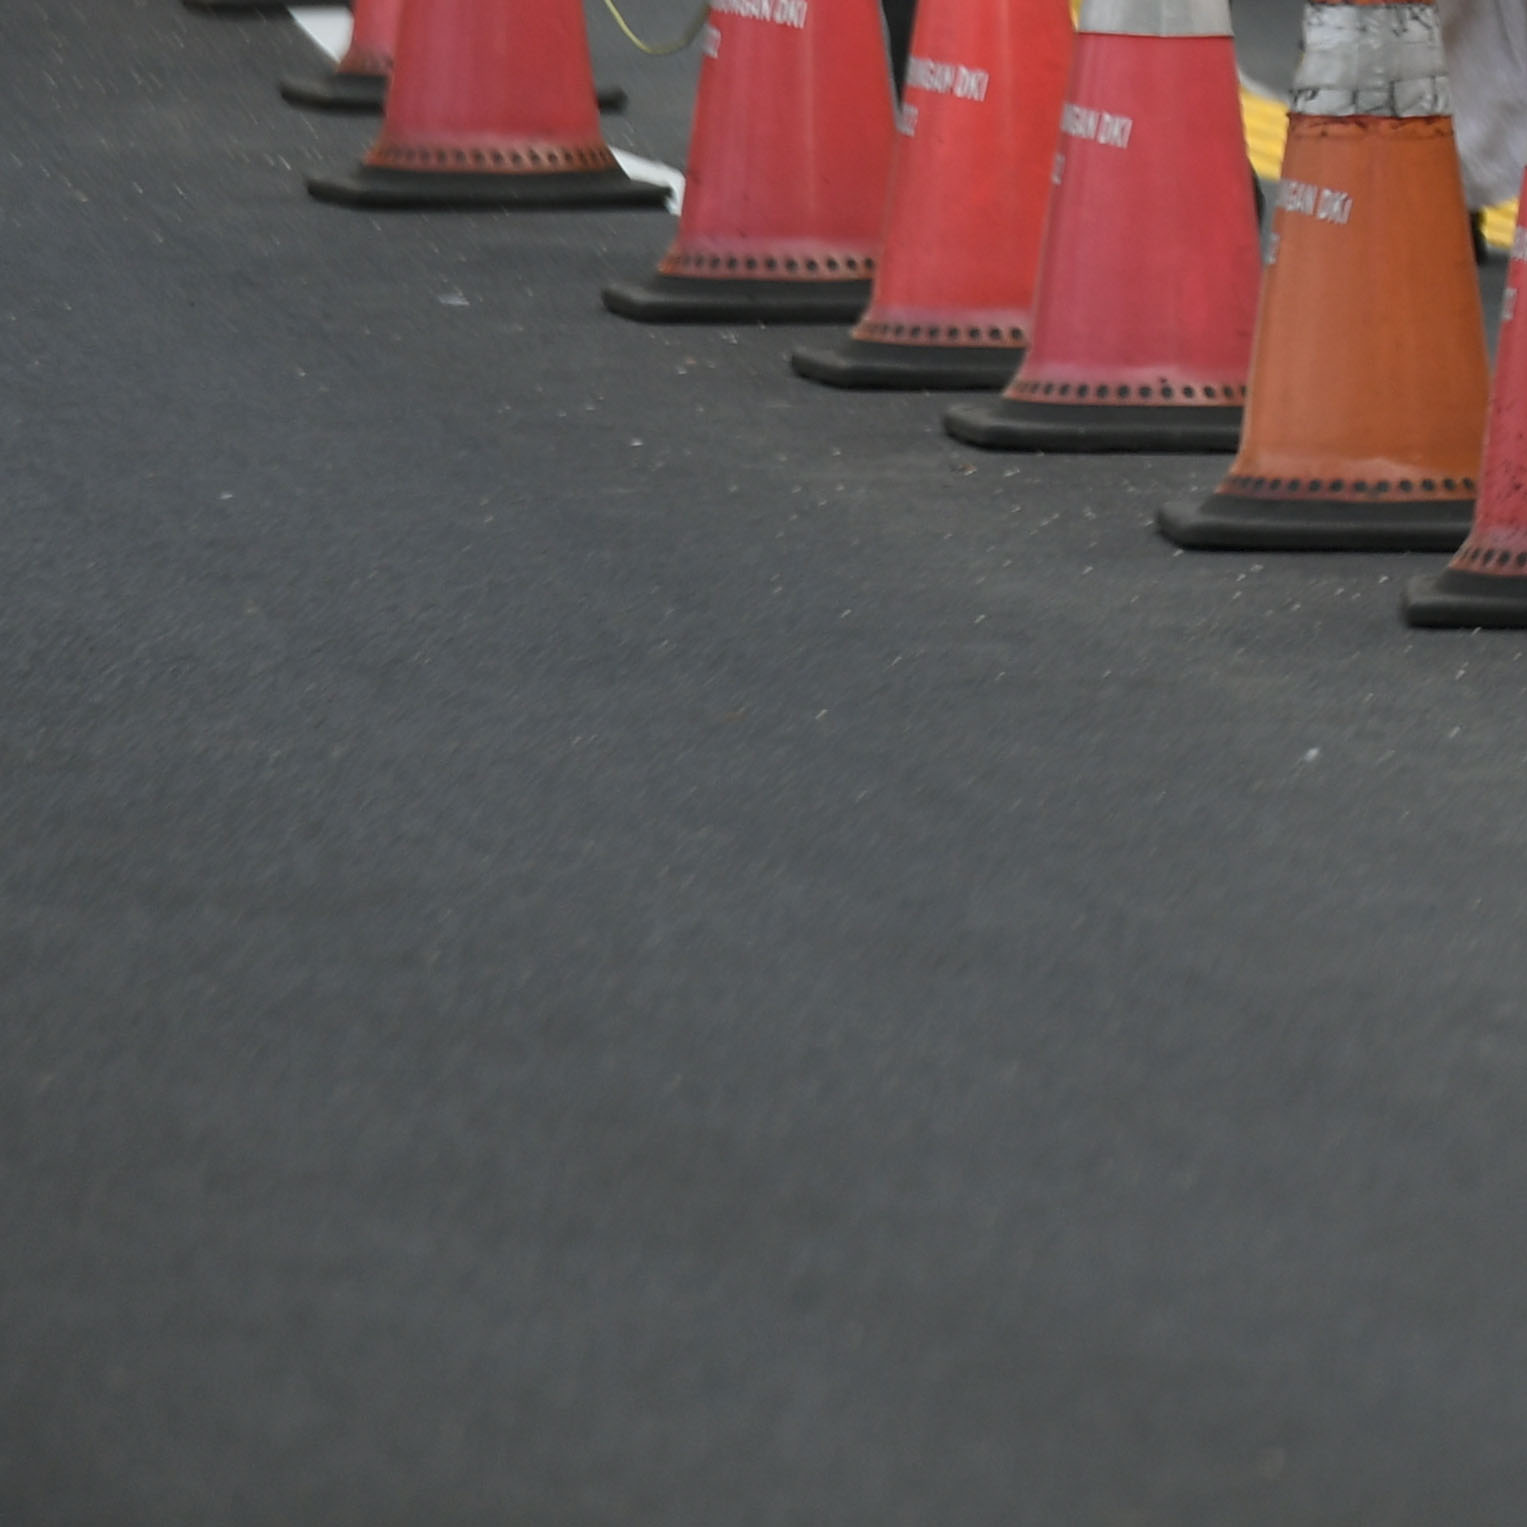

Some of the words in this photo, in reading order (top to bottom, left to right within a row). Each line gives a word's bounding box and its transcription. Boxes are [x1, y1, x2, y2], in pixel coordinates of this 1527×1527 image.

[954, 64, 989, 102] DKI
[1098, 110, 1133, 149] DKI
[1317, 186, 1352, 224] DKI
